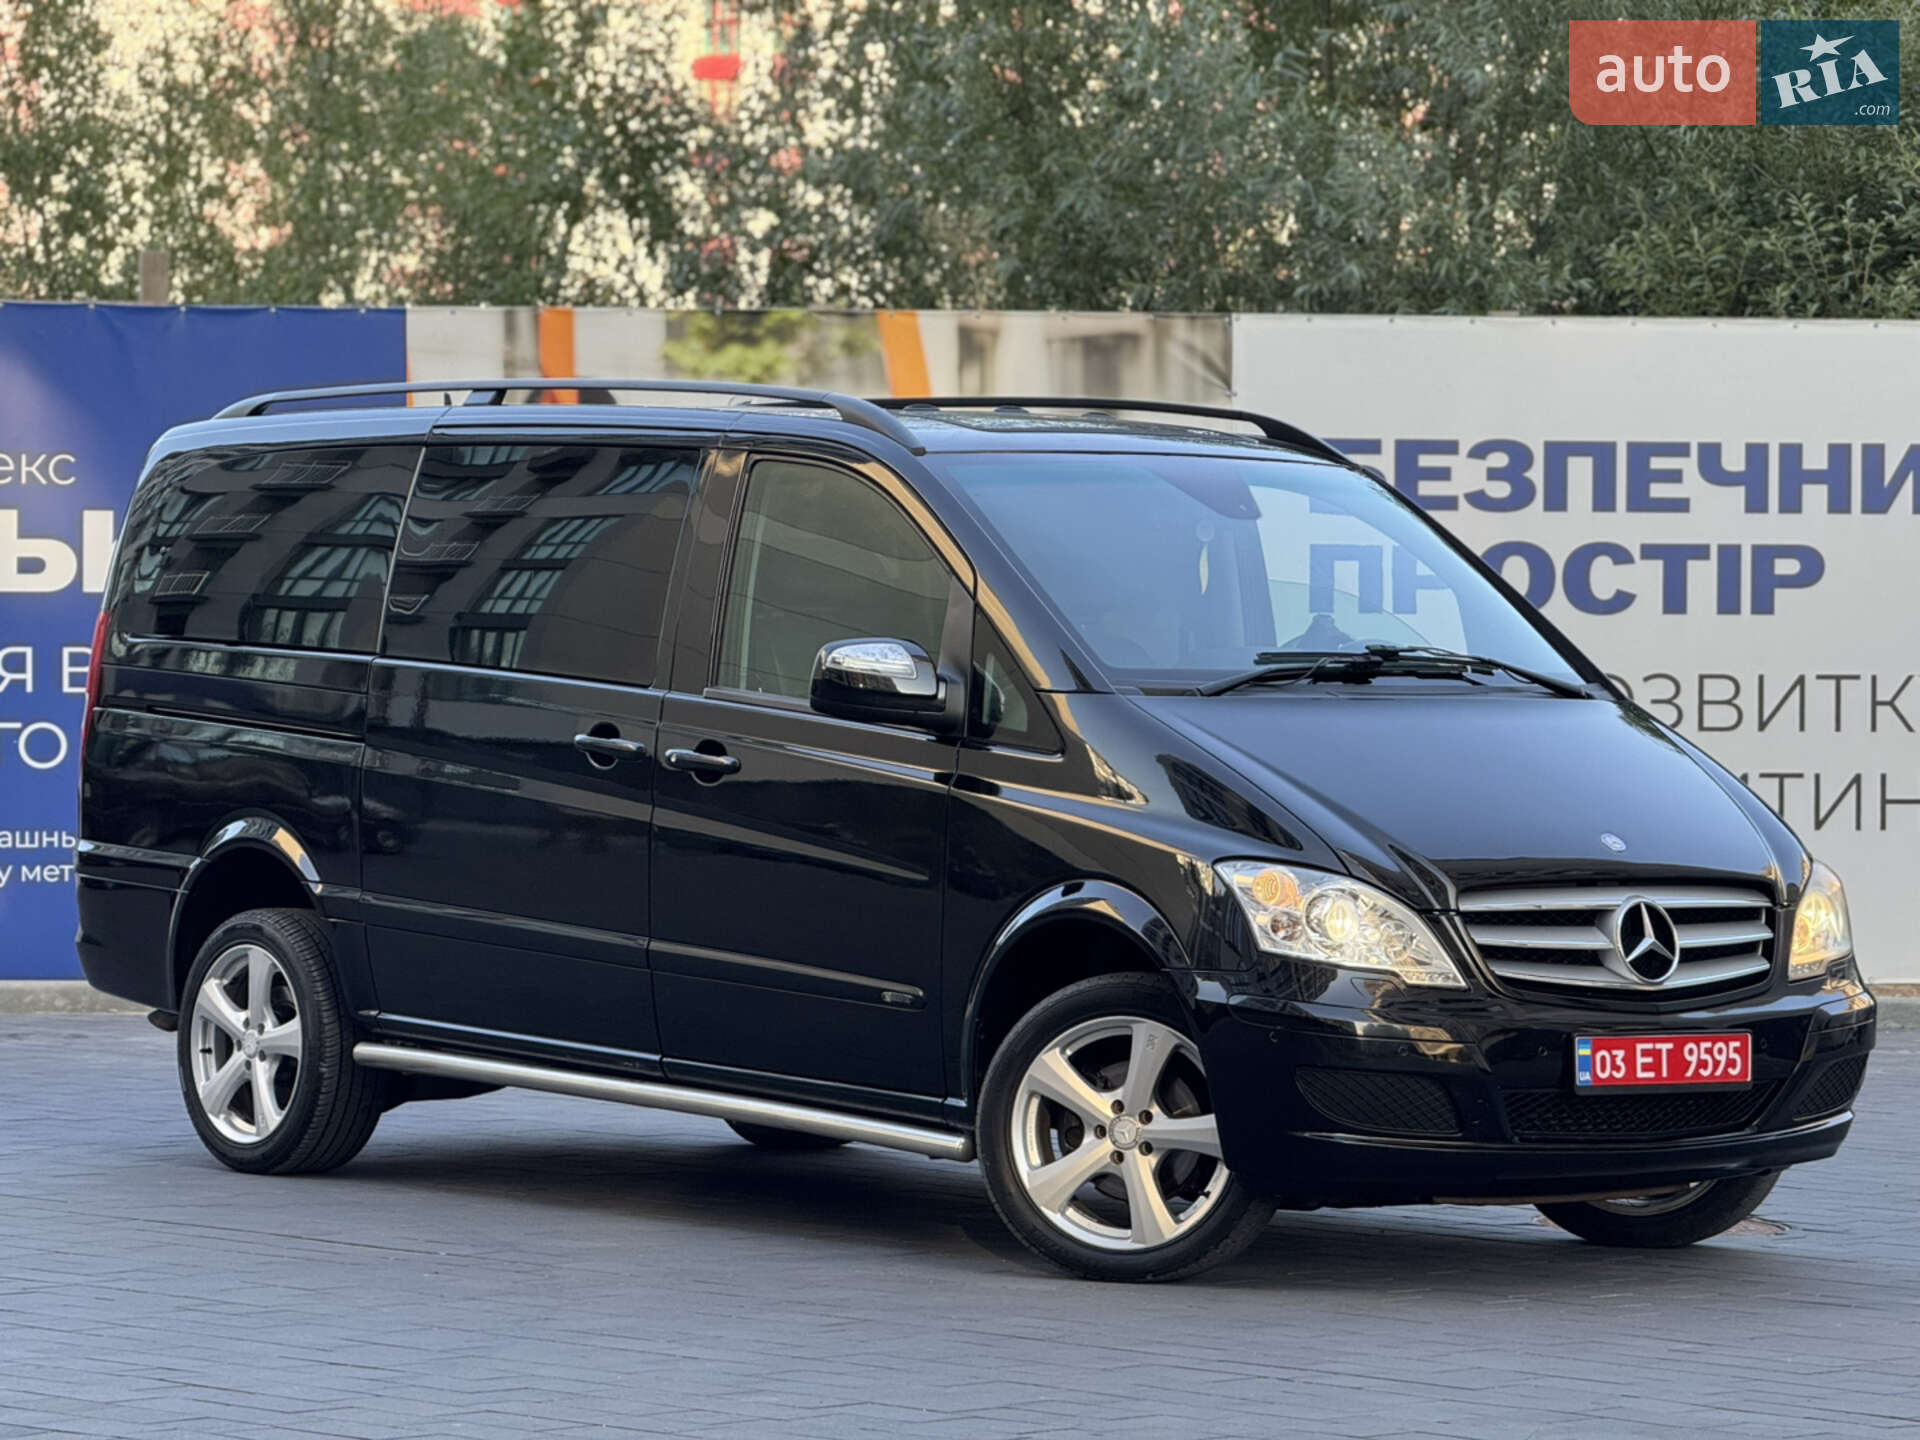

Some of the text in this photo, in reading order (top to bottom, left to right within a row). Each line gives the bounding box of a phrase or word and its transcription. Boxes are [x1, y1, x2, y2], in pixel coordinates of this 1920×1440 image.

[1739, 773, 1920, 831] ТИН
[1579, 1071, 1592, 1081] UA
[1595, 1041, 1742, 1079] 03 ET 9595
